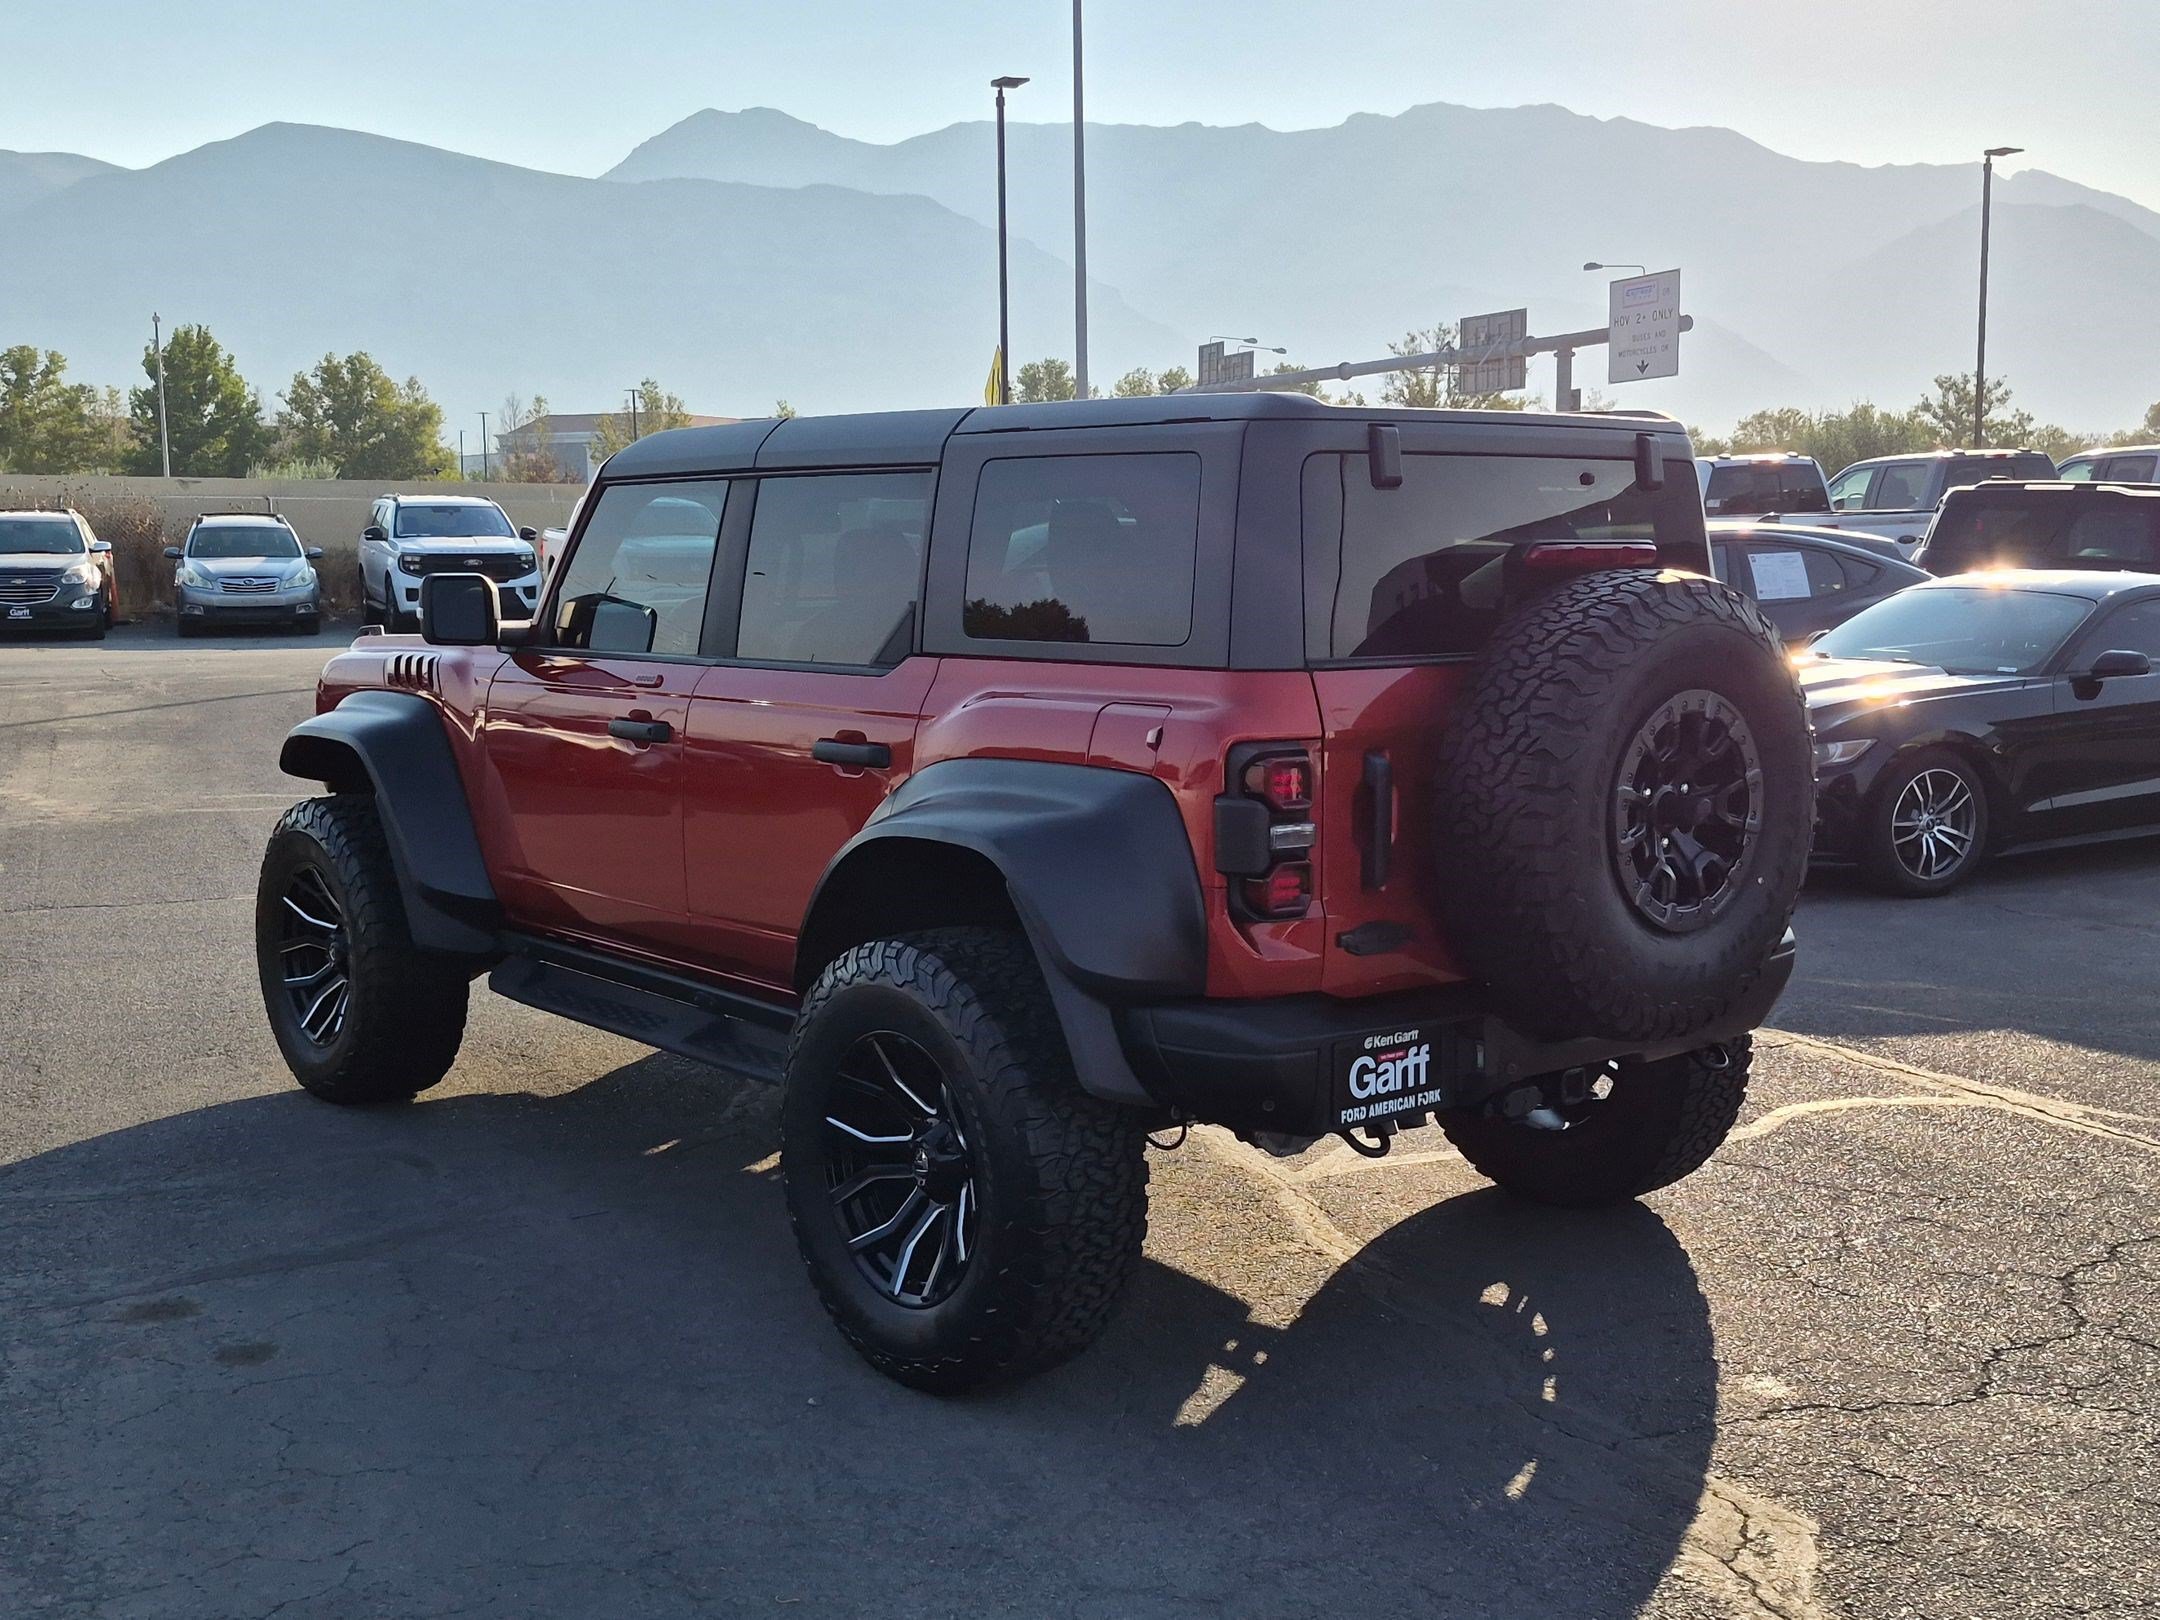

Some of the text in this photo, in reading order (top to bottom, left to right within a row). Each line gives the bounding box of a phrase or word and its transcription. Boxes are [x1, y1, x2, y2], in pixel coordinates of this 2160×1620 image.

[1613, 315, 1630, 327] HOV
[1652, 308, 1673, 321] ONLY
[1373, 1029, 1419, 1048] Ken Garff
[1349, 1043, 1430, 1099] Garff
[1341, 1088, 1441, 1124] FORD AMERICAN FORK
